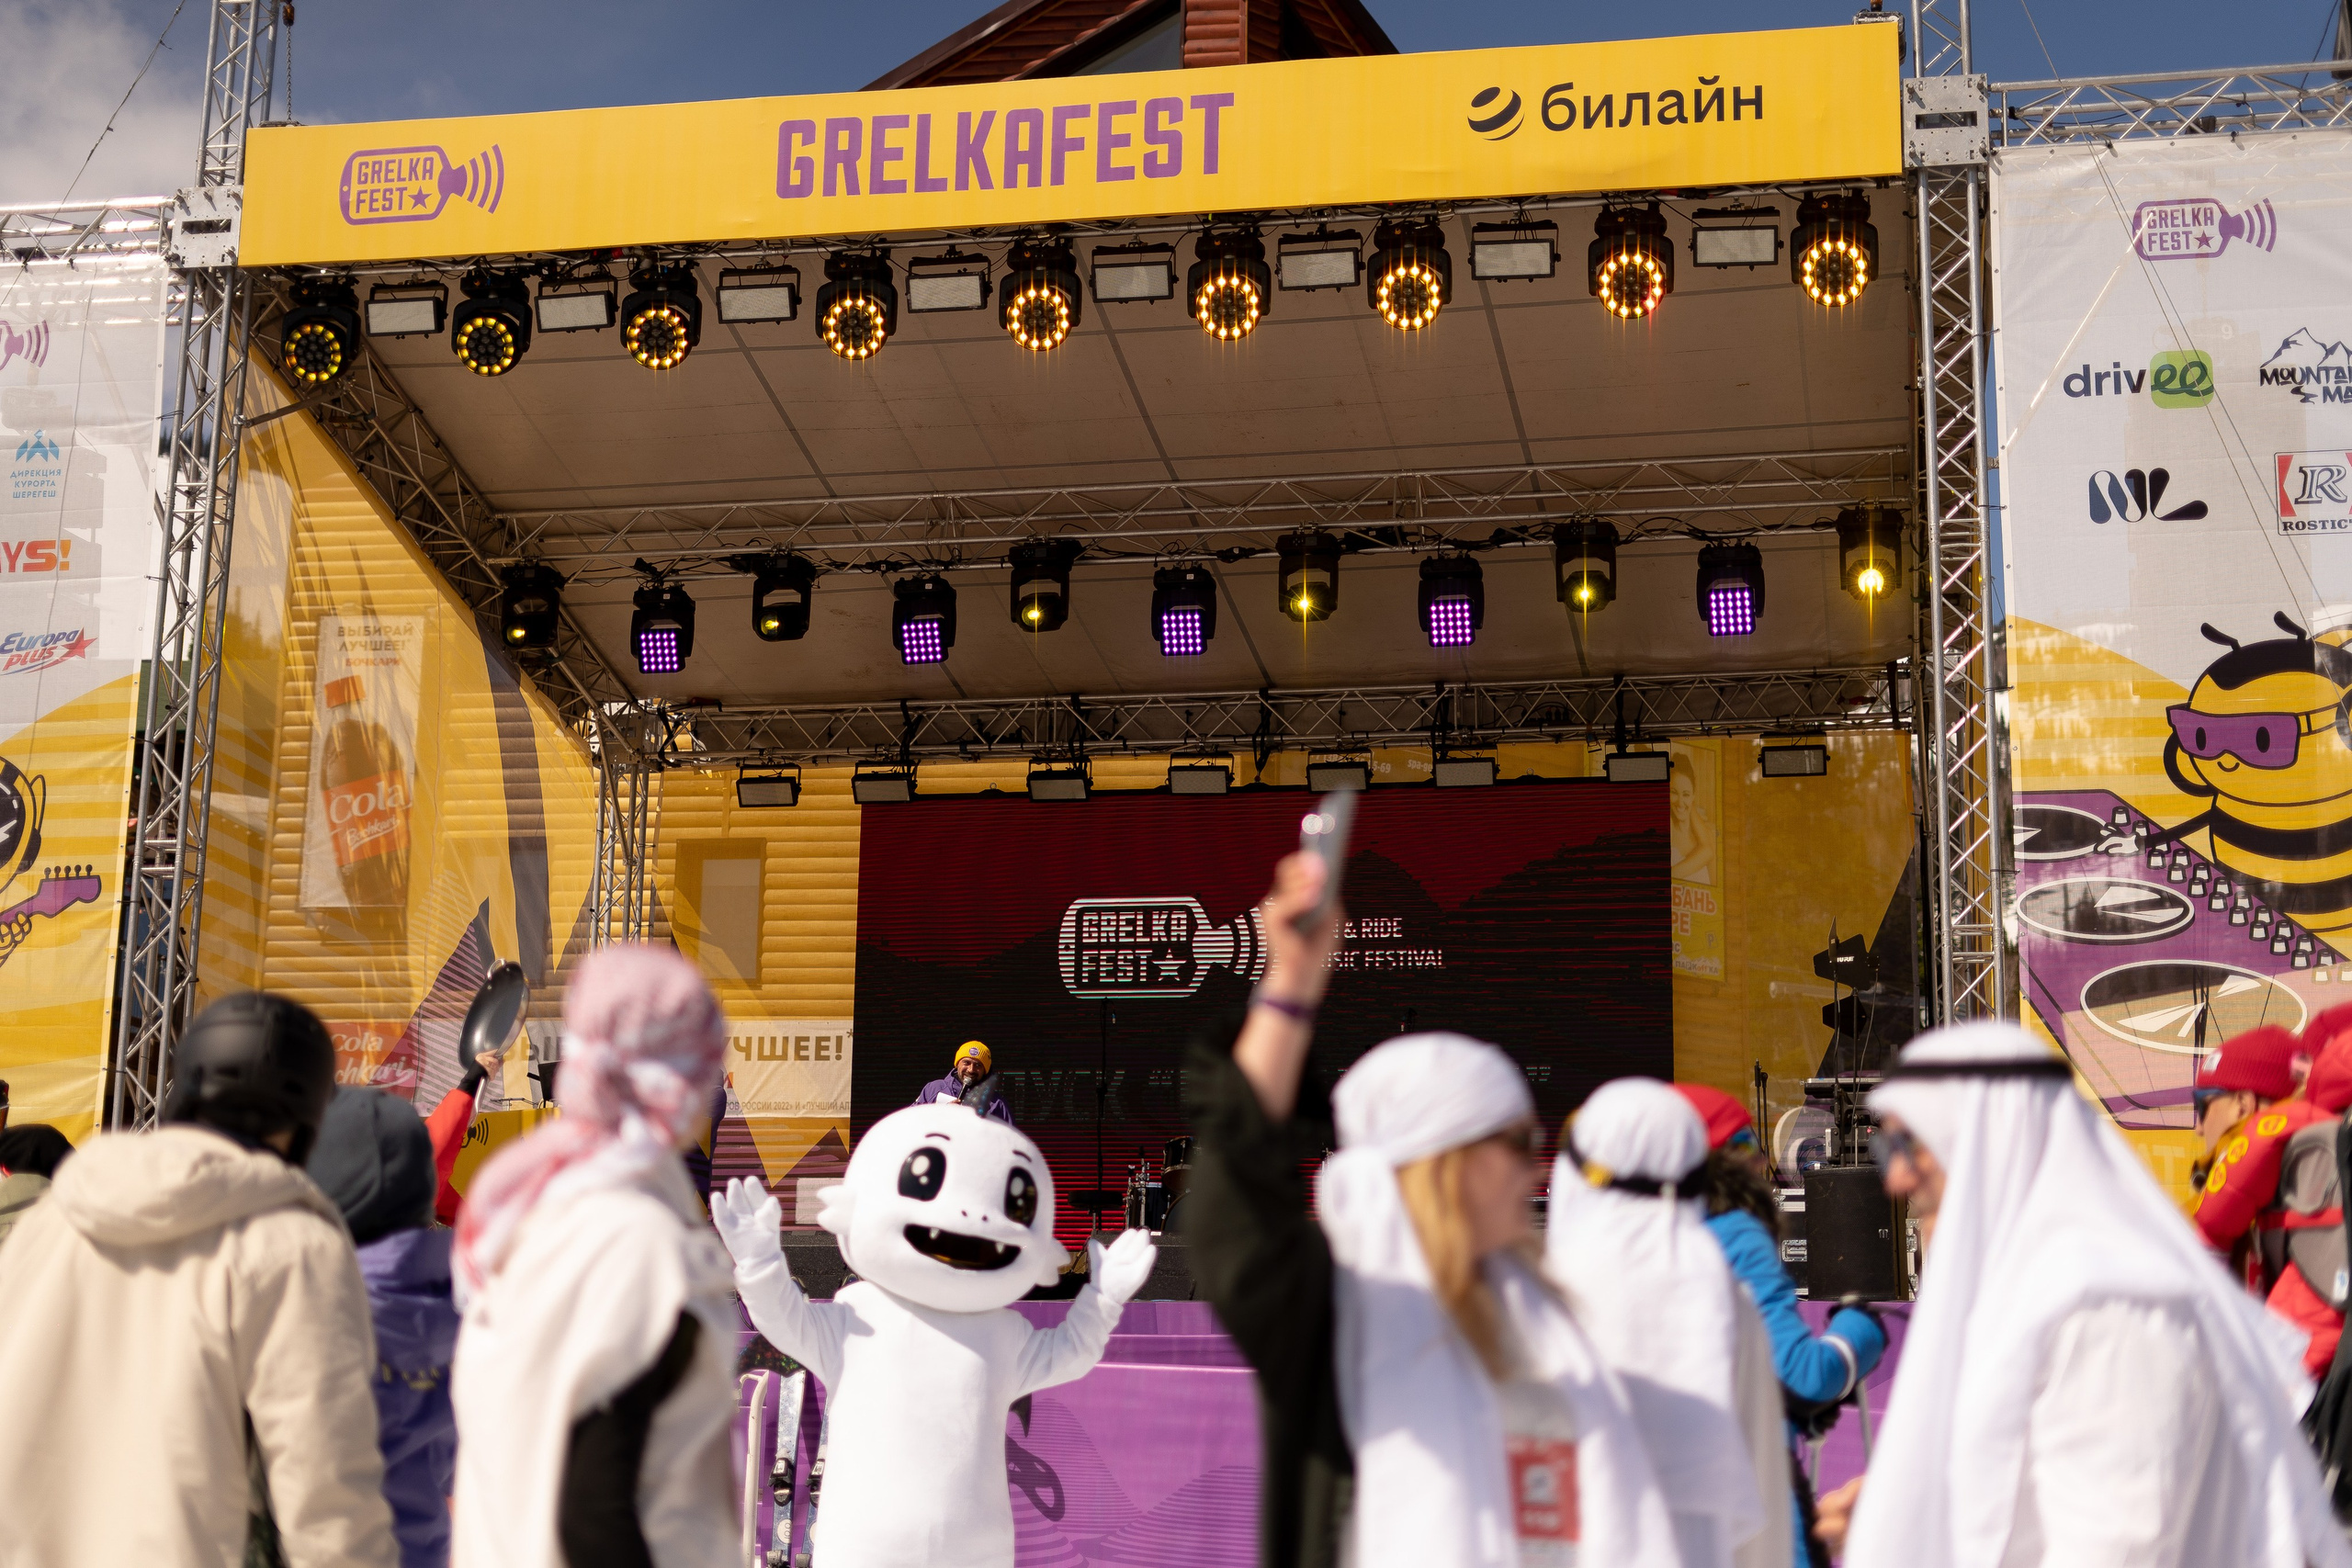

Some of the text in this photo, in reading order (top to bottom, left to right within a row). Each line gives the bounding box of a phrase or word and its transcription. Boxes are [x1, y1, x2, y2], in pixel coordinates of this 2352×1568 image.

[1541, 75, 1763, 131] билайн
[775, 92, 1235, 199] GRELKAFEST
[356, 156, 435, 185] GRELKA
[355, 186, 408, 213] FEST
[2146, 207, 2214, 229] GRELKA
[2147, 231, 2193, 252] FEST
[2063, 360, 2214, 398] drivee
[10, 468, 62, 479] ДИРЕКЦИЯ
[14, 479, 56, 489] КУРОРТА
[13, 490, 56, 499] ШЕРЕГЕШ
[0, 539, 72, 573] YS!
[337, 622, 414, 637] ВЫБИРАЙ
[330, 781, 412, 824] Cola
[1082, 910, 1187, 942] GRELKA
[1362, 918, 1403, 939] RIDE
[1081, 950, 1153, 983] FEST
[1365, 949, 1446, 971] FESTIVAL
[332, 1032, 383, 1052] Cola
[334, 1055, 410, 1086] chkari
[741, 1101, 773, 1111] РОССИИ
